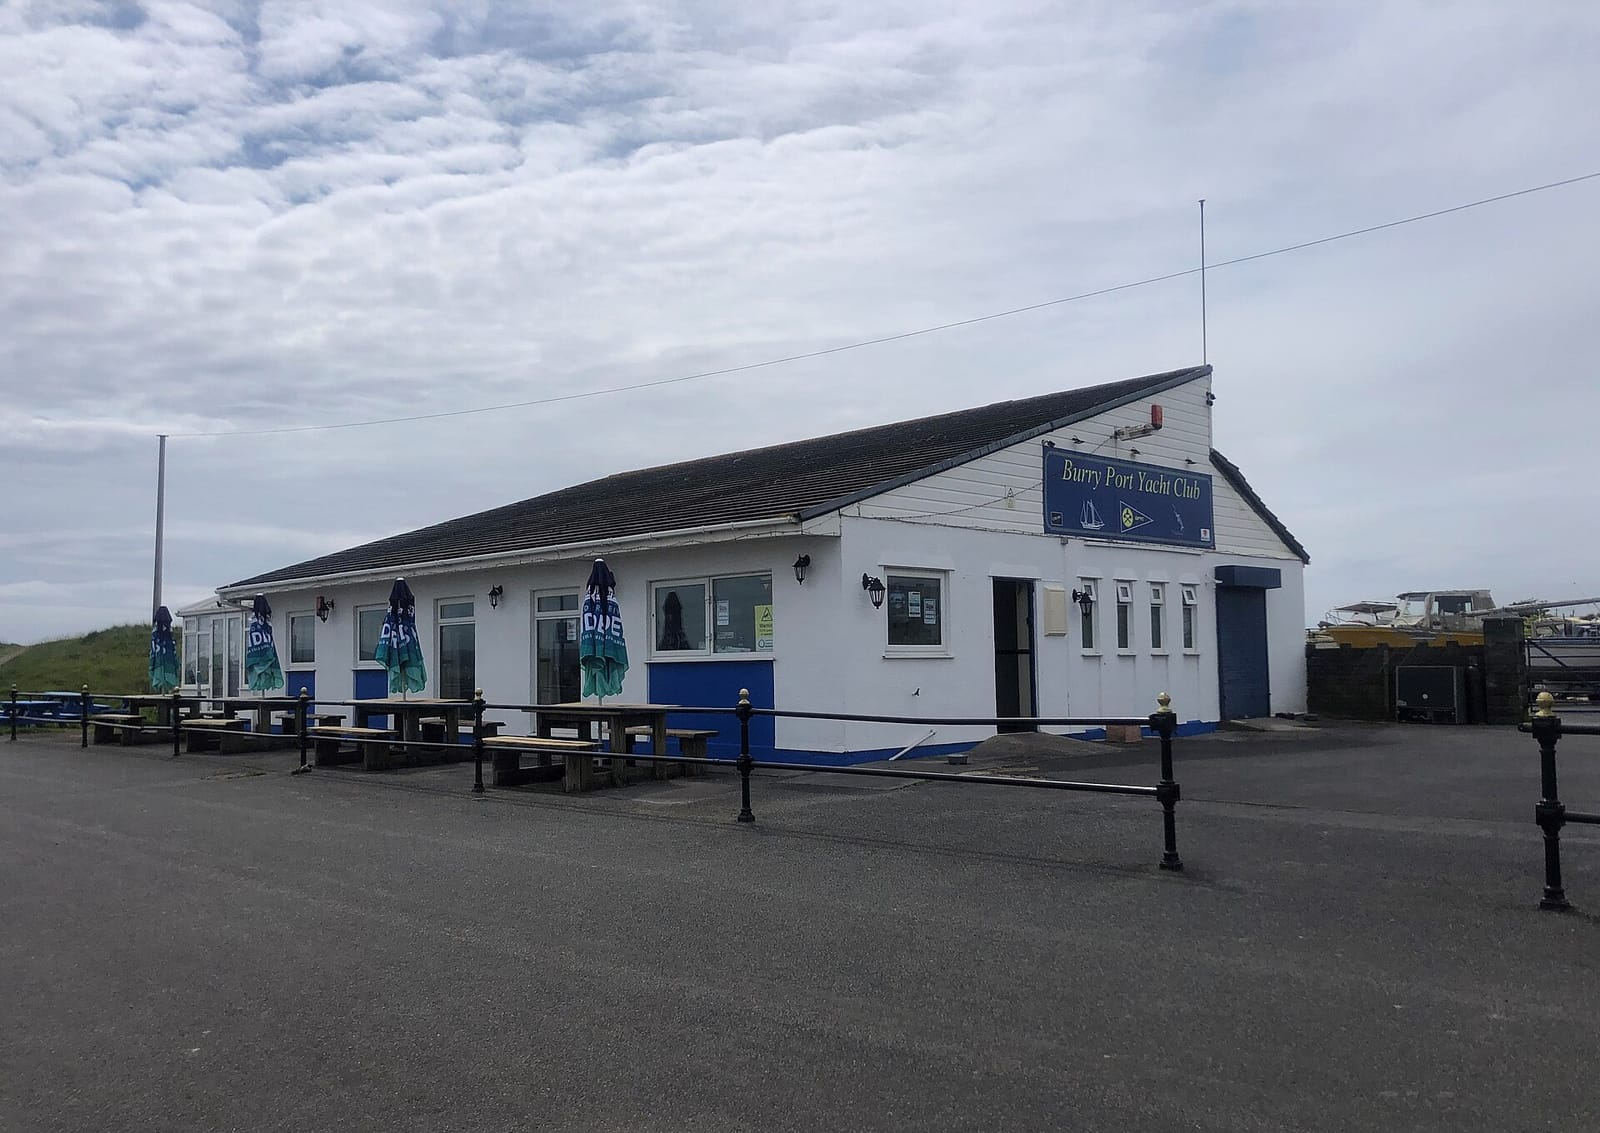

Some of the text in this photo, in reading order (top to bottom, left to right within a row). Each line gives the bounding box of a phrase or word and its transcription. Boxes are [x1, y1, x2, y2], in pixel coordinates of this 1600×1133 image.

[1062, 459, 1200, 500] Burry Port Yacht Club
